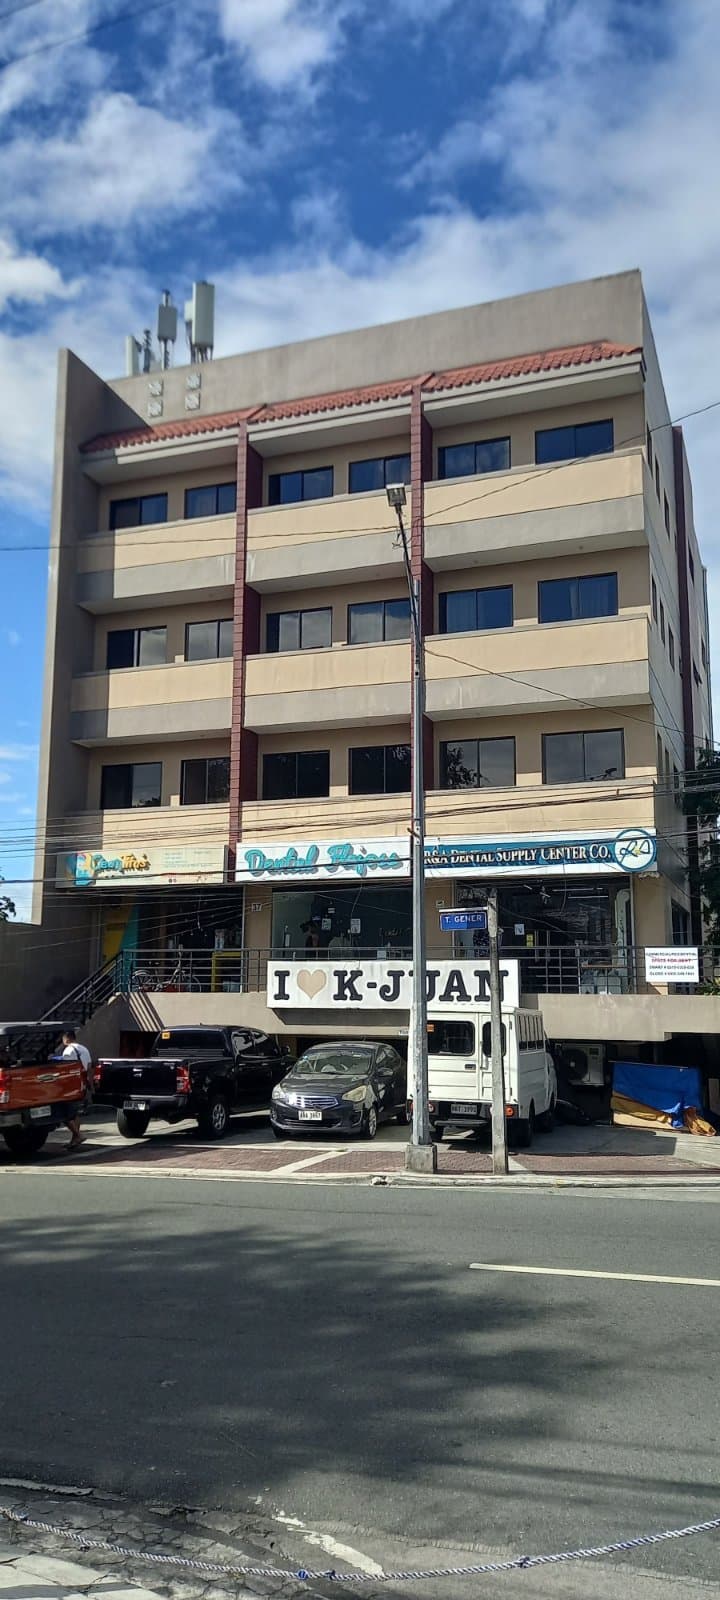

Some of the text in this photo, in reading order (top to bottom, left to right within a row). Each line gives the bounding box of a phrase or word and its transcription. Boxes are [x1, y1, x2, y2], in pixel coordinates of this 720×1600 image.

[244, 845, 320, 877] Dental
[450, 848, 495, 864] DENTAL
[496, 847, 537, 862] SUPPLY
[540, 845, 586, 861] CENTER
[454, 914, 482, 923] GENER
[273, 969, 290, 1001] I
